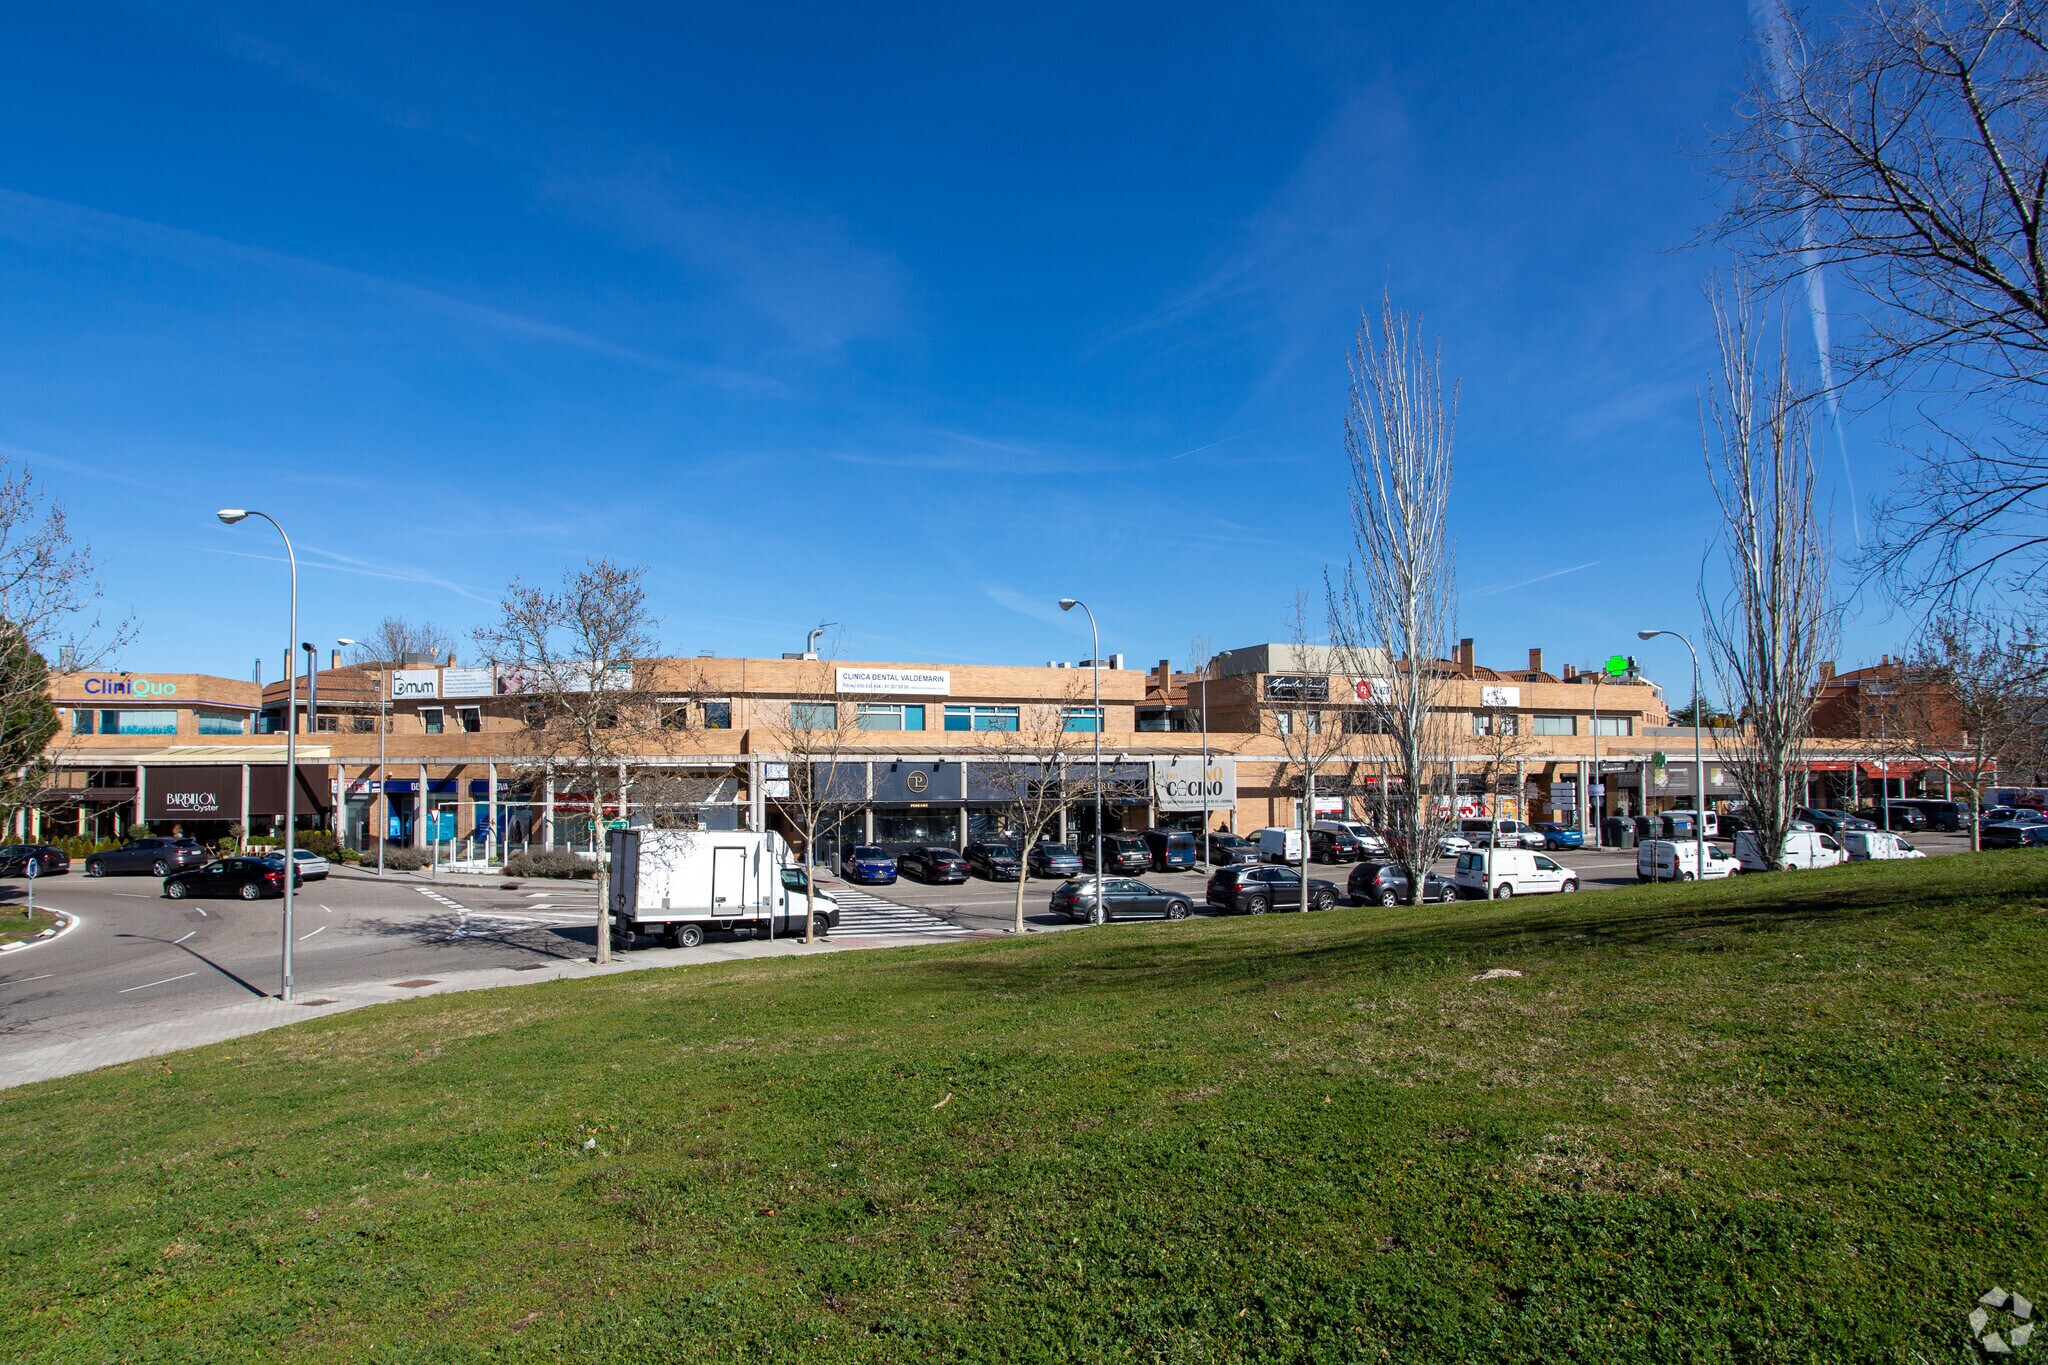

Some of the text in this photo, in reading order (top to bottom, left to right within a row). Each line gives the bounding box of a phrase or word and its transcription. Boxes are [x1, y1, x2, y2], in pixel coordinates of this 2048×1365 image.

[843, 673, 944, 683] CLINICA DENTAL VALDEMARIN
[84, 678, 176, 698] CliniQuo
[193, 804, 219, 812] Oyster
